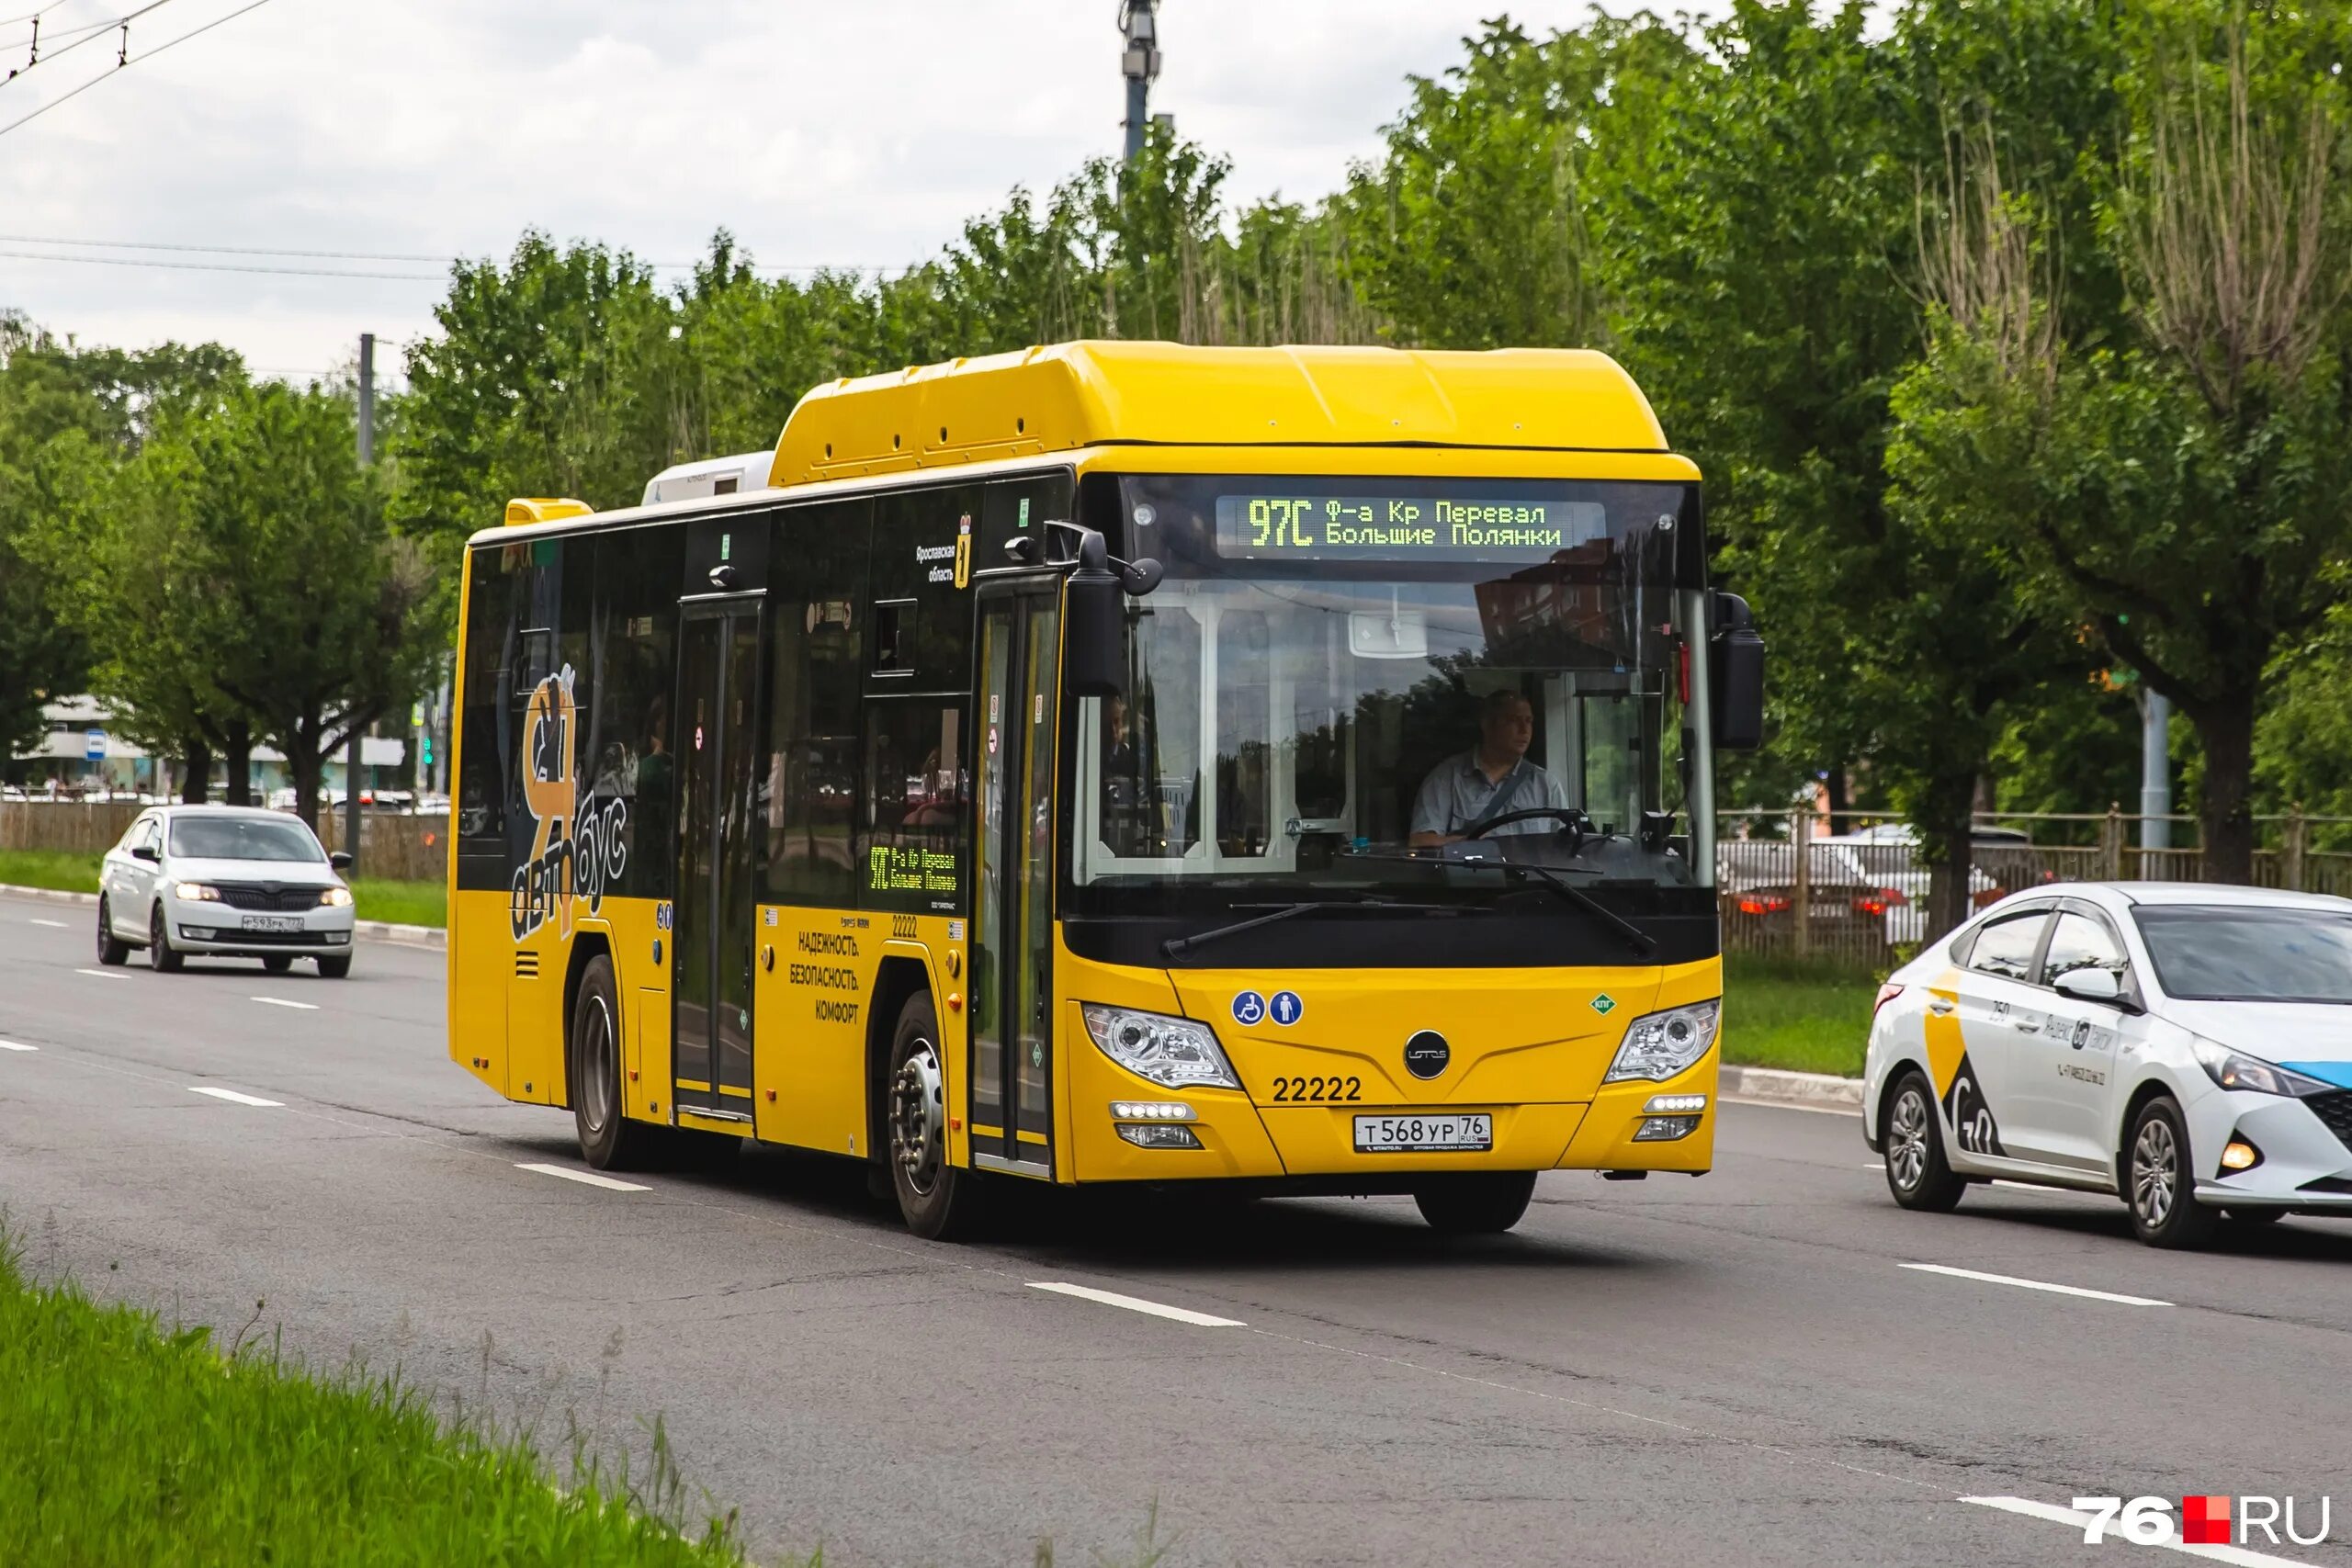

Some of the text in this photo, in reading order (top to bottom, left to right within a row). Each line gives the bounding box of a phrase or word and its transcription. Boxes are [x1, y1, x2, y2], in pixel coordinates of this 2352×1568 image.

[1249, 499, 1312, 547] 97С
[1326, 500, 1545, 525] Ф-а Кр Перевал
[1326, 524, 1561, 546] Большие Полянки
[917, 546, 956, 564] Ярославская
[929, 566, 954, 582] область
[892, 914, 918, 938] 22222
[798, 931, 860, 957] НАДЕЖНОСТЬ.
[790, 964, 859, 991] БЕЗОПАСНОСТЬ.
[815, 999, 859, 1025] КОМФОРТ
[1272, 1077, 1362, 1101] 22222
[1462, 1117, 1483, 1135] 76
